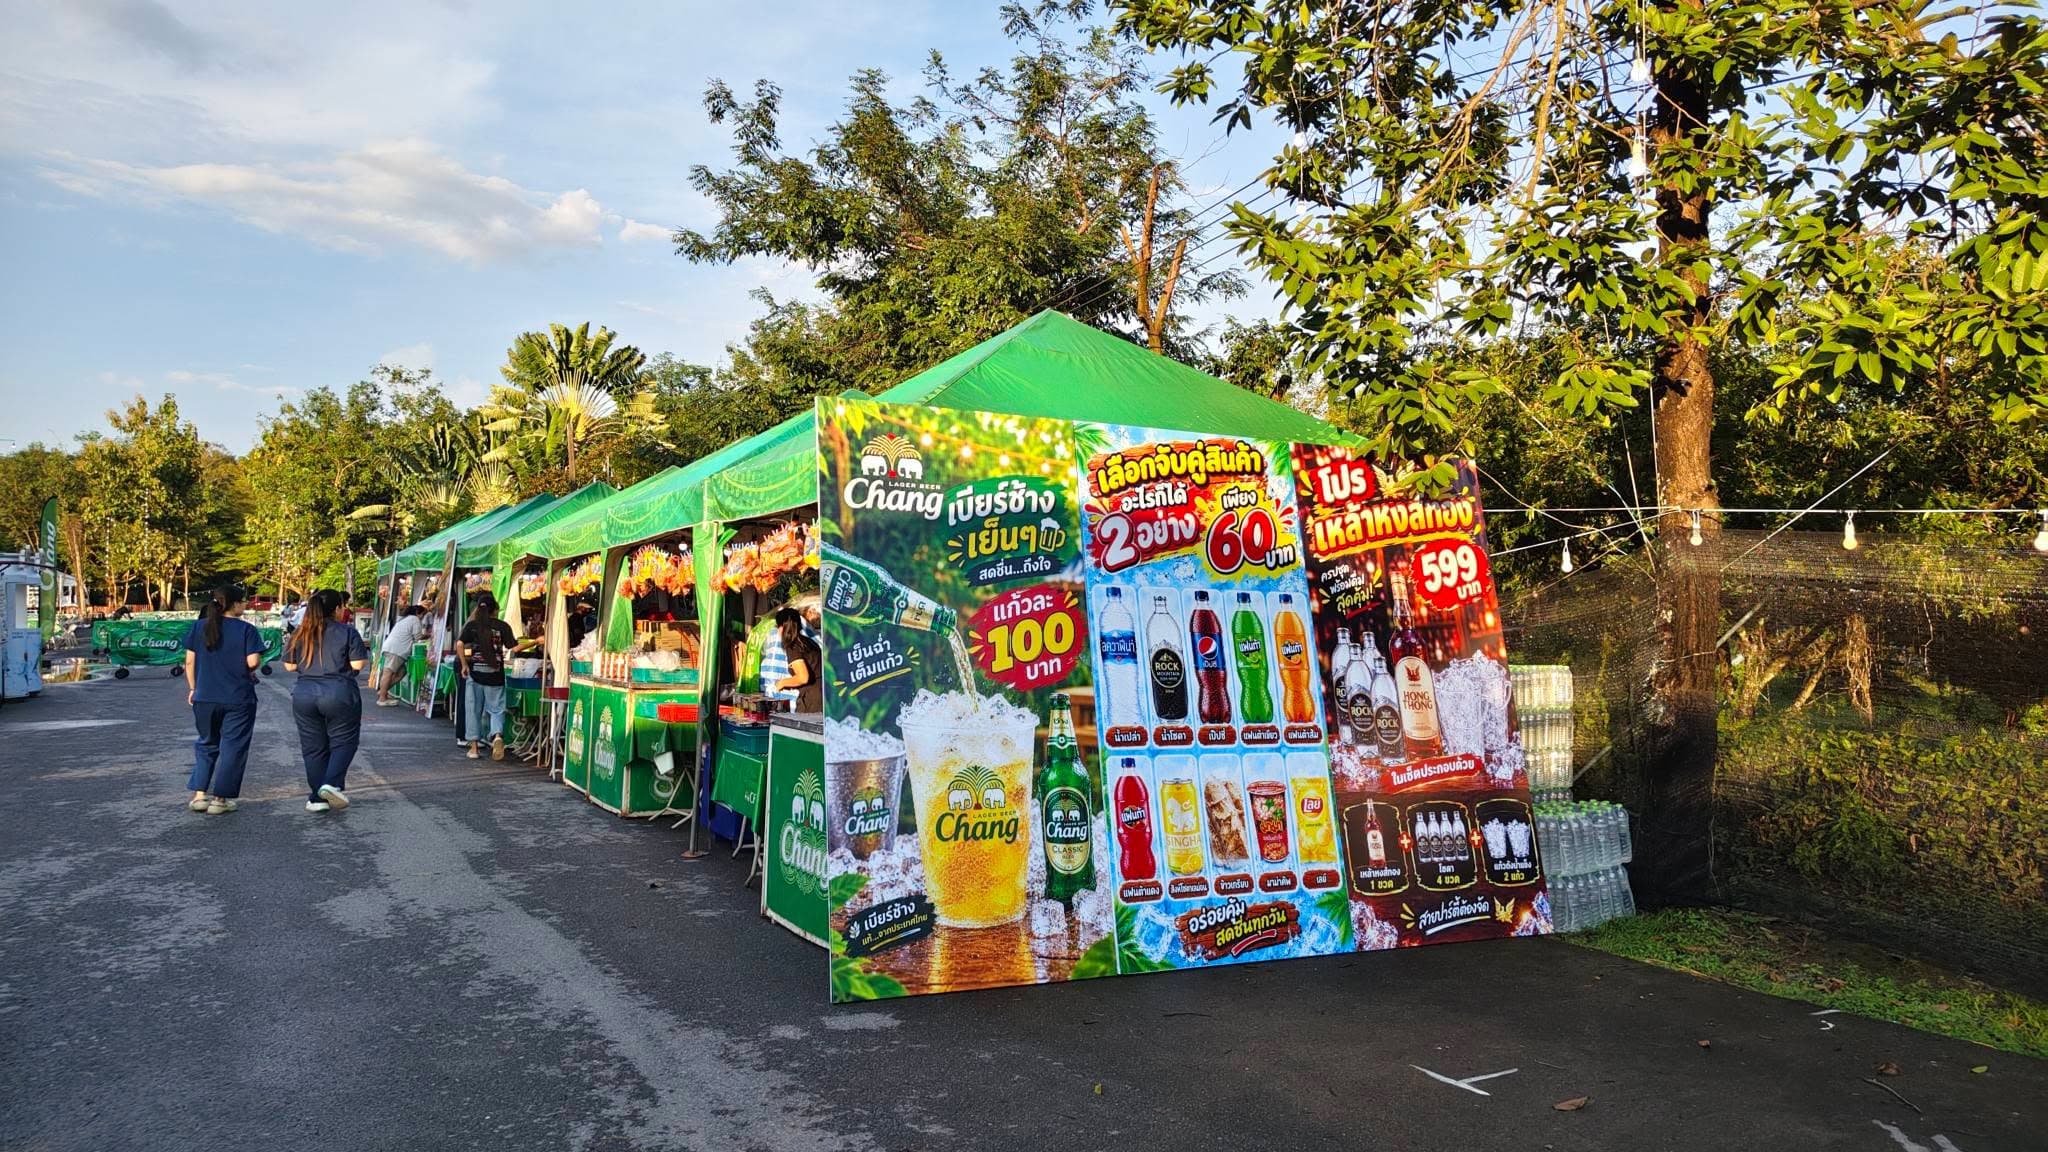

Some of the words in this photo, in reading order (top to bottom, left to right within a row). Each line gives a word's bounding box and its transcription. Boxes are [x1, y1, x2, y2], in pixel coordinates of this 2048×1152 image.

[1097, 442, 1262, 494] เลือกจับคู่สินค้า
[1317, 463, 1367, 503] โปร
[843, 477, 944, 521] Chang
[948, 479, 1056, 527] เบียร์ช้าง
[1121, 481, 1188, 512] อะไรก็ได้
[1222, 487, 1257, 509] เพียง
[967, 516, 1037, 559] เย็นๆ
[1099, 513, 1137, 569] 2
[1136, 507, 1196, 548] อย่าง
[1207, 509, 1276, 573] 60
[1265, 545, 1296, 569] บาท
[42, 520, 56, 591] Cang
[979, 556, 1051, 581] สดชื่น...ถึงใจ
[1420, 545, 1478, 593] 599
[828, 569, 851, 611] Chang
[1456, 580, 1482, 600] บาท
[993, 591, 1054, 622] แก้วละ
[139, 637, 179, 649] Chang
[847, 632, 891, 664] เย็นฉ่ำ
[987, 611, 1075, 673] 100
[850, 652, 904, 683] เต็มแก้ว
[1026, 657, 1062, 681] บาท
[1155, 662, 1179, 671] ROCK
[1403, 691, 1430, 701] HONG
[1403, 699, 1433, 711] THONG
[1351, 706, 1373, 717] ROCK
[1376, 718, 1399, 728] ROCK
[1114, 729, 1141, 742] น้ำเปล่า
[1161, 729, 1186, 741] น้ำโซดา
[1390, 756, 1475, 786] ในเซ็ตประกอบด้วย
[845, 814, 890, 835] Chang
[935, 812, 1019, 845] Chang
[1046, 821, 1088, 841] Chang
[781, 823, 830, 891] Chang
[1052, 844, 1083, 853] CLASSIC
[1370, 880, 1375, 890] 1
[1378, 880, 1394, 889] ขวด
[1436, 875, 1442, 885] 4
[1444, 875, 1460, 884] ขวด
[1503, 872, 1509, 881] 2
[864, 901, 916, 931] เบียร์ช้าง
[1188, 898, 1246, 933] อร่อยคุ้ม
[1215, 907, 1287, 947] สดชื่นทุกวัน
[1418, 895, 1490, 930] สายปาร์ตี้ต้องจัด
